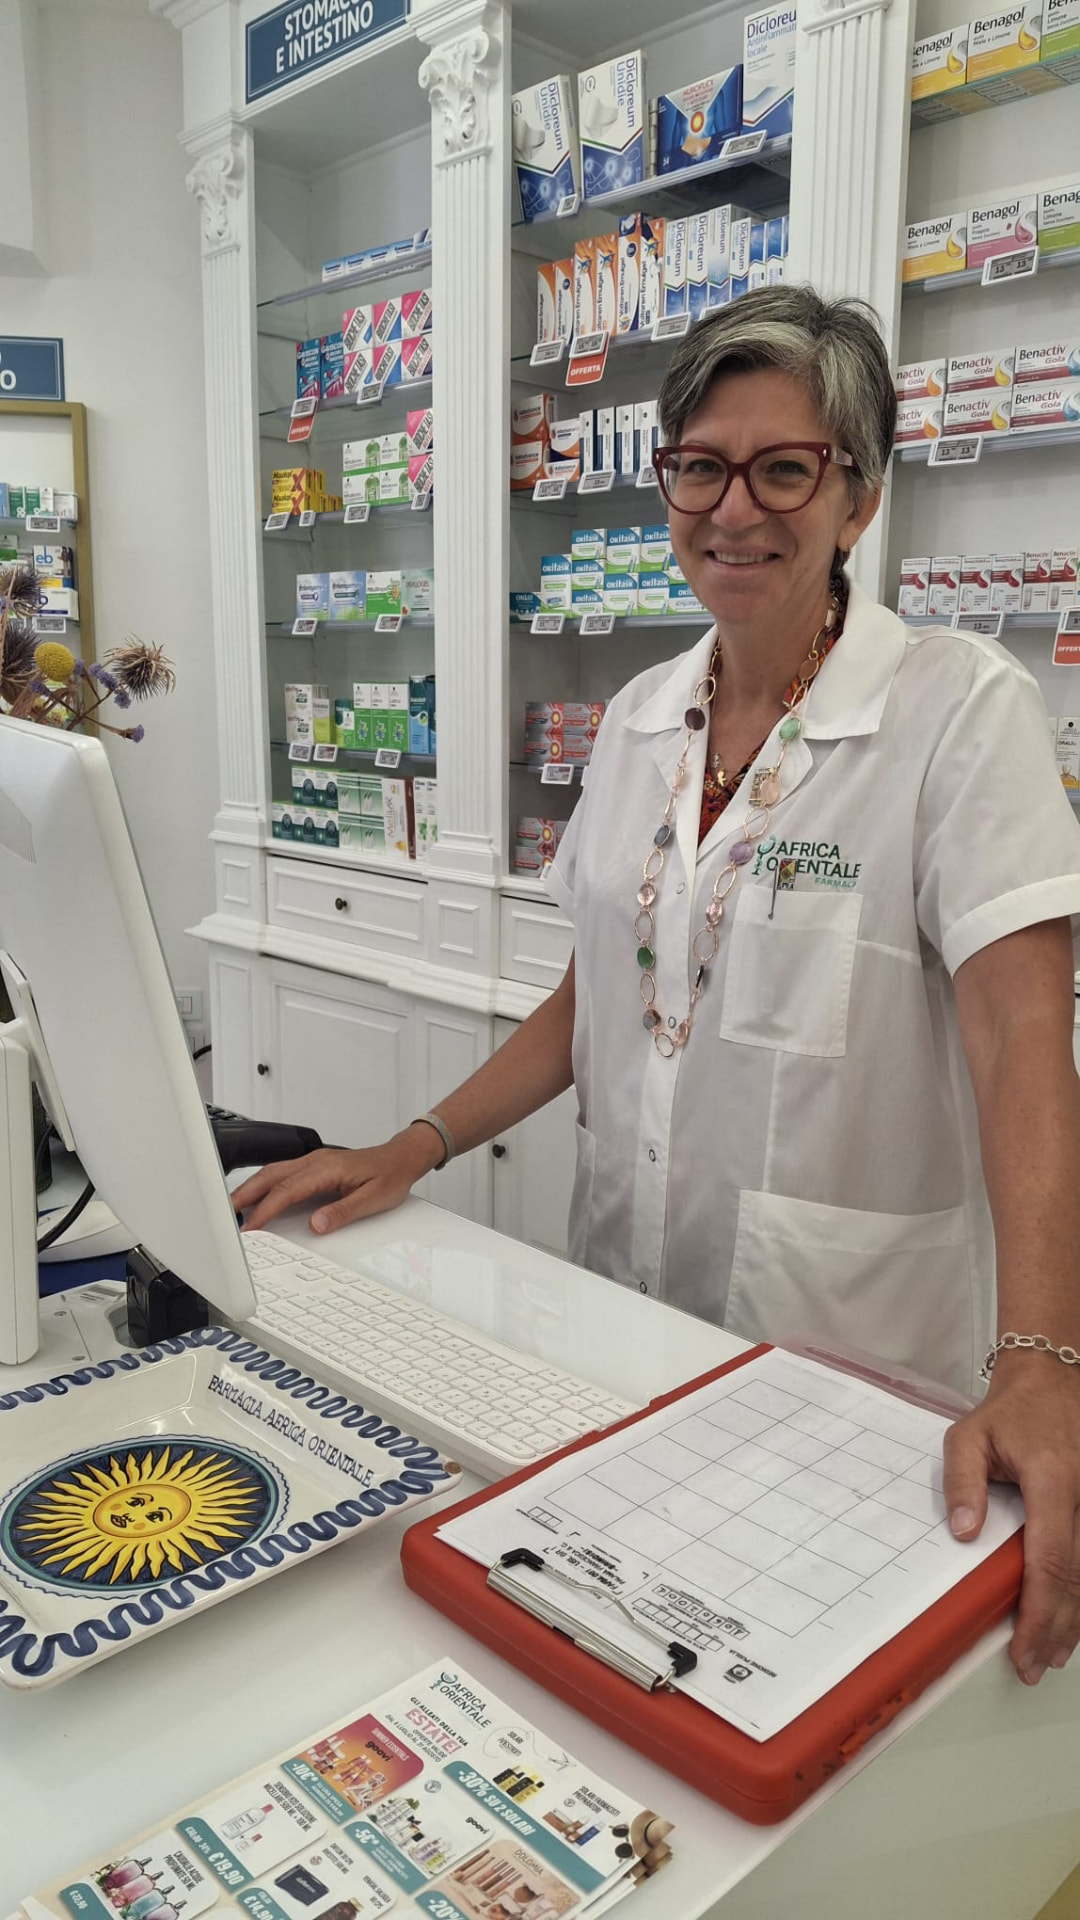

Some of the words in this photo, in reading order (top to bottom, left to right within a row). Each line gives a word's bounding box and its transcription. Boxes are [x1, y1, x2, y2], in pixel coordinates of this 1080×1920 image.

[285, 0, 361, 40] STOMAC
[747, 9, 797, 39] Dicloreu
[974, 6, 1026, 34] Benagol
[276, 47, 285, 74] E
[288, 0, 374, 67] INTESTINO
[616, 61, 625, 107] Unidie
[625, 57, 636, 128] Dicloreum
[540, 86, 551, 131] Unidie
[548, 82, 563, 152] Dicloreum
[972, 201, 1021, 224] Benagol
[719, 207, 728, 255] Dicloreum
[907, 217, 952, 240] Benagol
[675, 221, 685, 278] Dicloreum
[696, 215, 707, 272] Dicloreum
[738, 221, 747, 271] Dicloreum
[951, 356, 994, 371] Benactiv
[1019, 344, 1067, 361] Benactiv
[1044, 355, 1066, 365] Gola
[0, 368, 17, 391] O
[571, 365, 601, 376] OFFERTA
[896, 367, 926, 380] nactiv
[907, 376, 926, 386] Gola
[974, 366, 994, 375] Gola
[947, 399, 991, 414] Benactiv
[1015, 389, 1062, 405] Benactiv
[1040, 401, 1062, 409] Gola
[905, 419, 923, 427] Gola
[971, 410, 990, 419] Gola
[609, 534, 637, 544] oxitask
[542, 562, 571, 572] oxitask
[575, 563, 599, 572] oxitask
[606, 579, 634, 589] oxitask
[641, 578, 669, 588] oxitask
[38, 586, 49, 605] b
[776, 841, 841, 860] AFRICA
[766, 857, 862, 879] OENTALE
[308, 1435, 374, 1488] ORIENTALE
[555, 1549, 568, 1558] BR
[439, 1686, 492, 1729] ORIENTALE
[451, 1683, 487, 1712] AFRICA
[405, 1708, 462, 1755] ESTATE!
[410, 1696, 421, 1707] GLI
[420, 1703, 441, 1723] ALLEATI
[439, 1719, 457, 1737] DELLA
[456, 1734, 469, 1747] TUA
[365, 1740, 394, 1762] goovi
[422, 1746, 441, 1763] AGOSTO
[458, 1769, 493, 1798] -30%
[484, 1791, 499, 1806] SU
[495, 1801, 505, 1812] 2
[501, 1808, 537, 1836] SOLARI
[465, 1815, 490, 1835] goovi
[173, 1850, 195, 1873] CAUDALIE
[207, 1851, 245, 1885] €19,90
[163, 1854, 187, 1881] PROFUMATE
[181, 1876, 190, 1885] 50
[187, 1882, 197, 1892] ML
